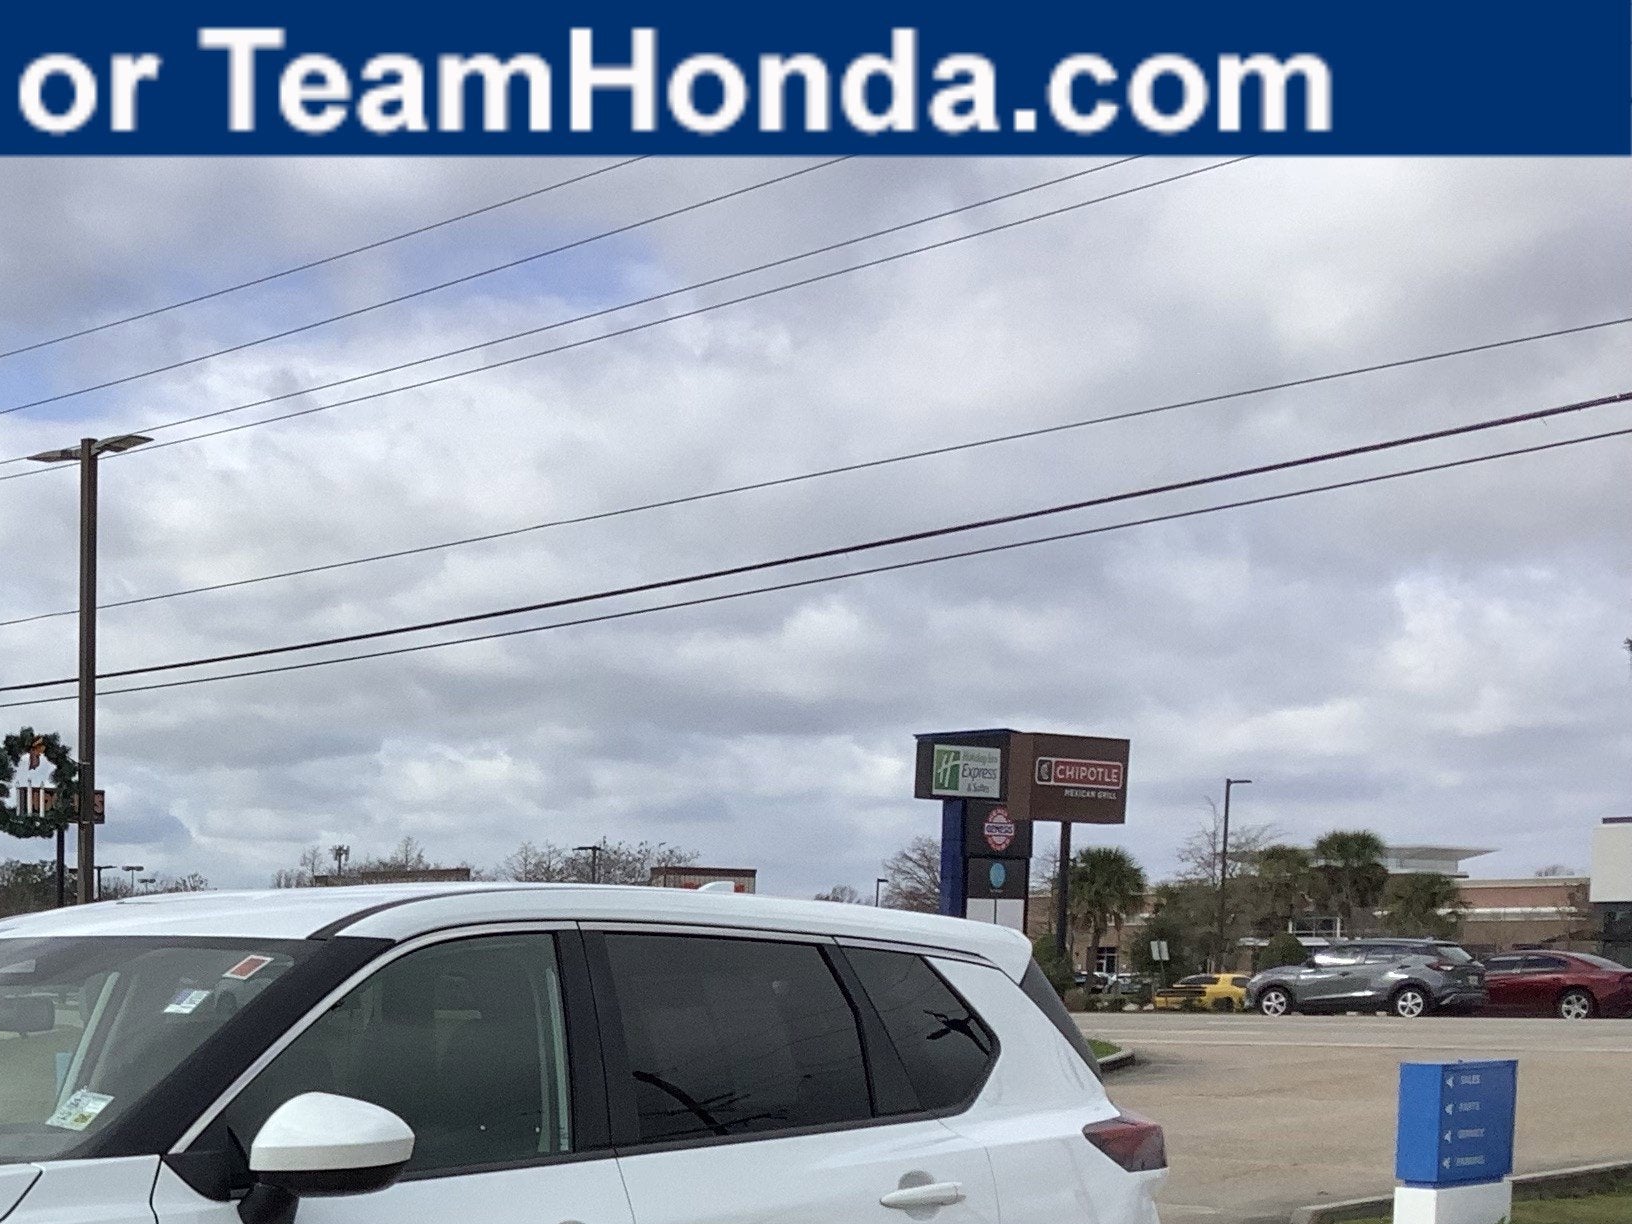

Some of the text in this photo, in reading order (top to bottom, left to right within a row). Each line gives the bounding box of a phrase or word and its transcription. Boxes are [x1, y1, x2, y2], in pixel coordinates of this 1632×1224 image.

[961, 763, 998, 781] Express
[1056, 764, 1119, 782] CHIPOTLE
[1064, 789, 1117, 800] MEXICAN GRILL
[1460, 1074, 1481, 1085] SALES
